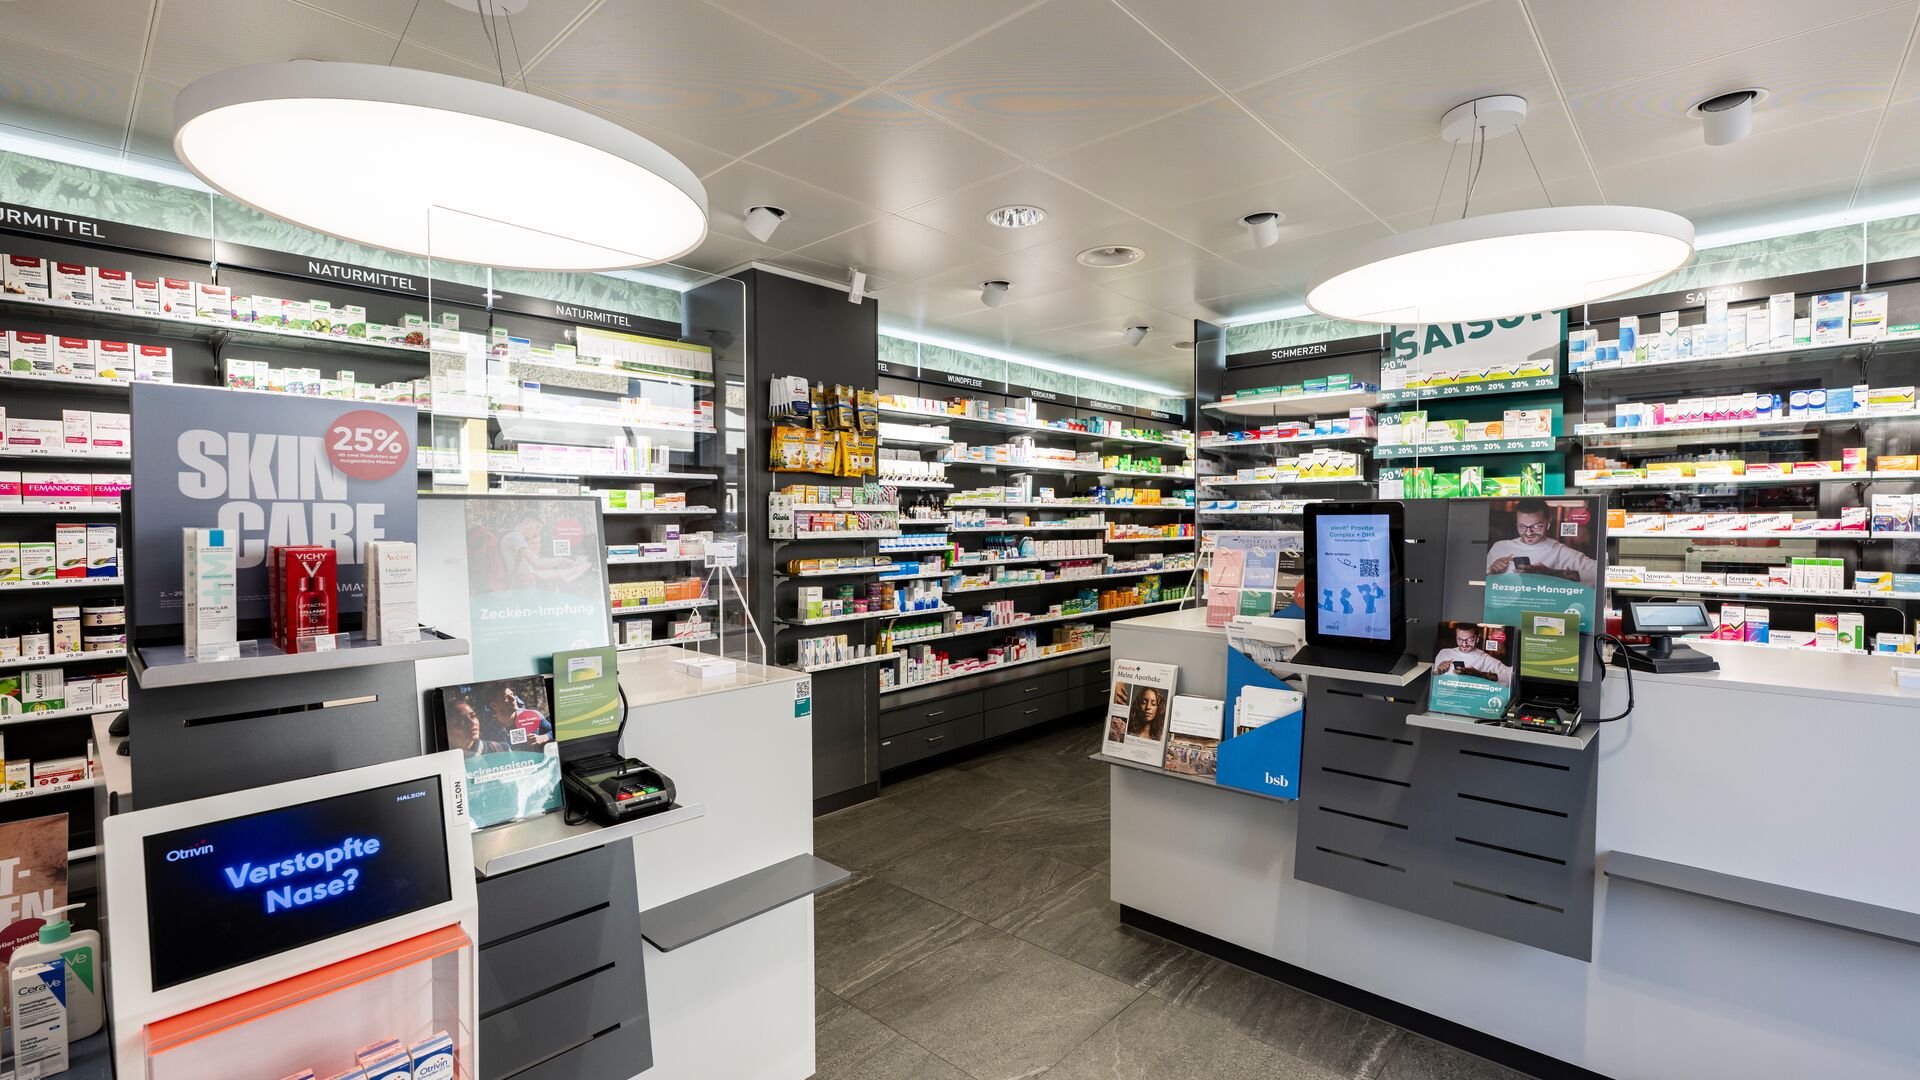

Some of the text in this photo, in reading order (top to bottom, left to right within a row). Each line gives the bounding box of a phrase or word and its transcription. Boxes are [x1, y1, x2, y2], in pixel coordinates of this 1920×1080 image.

[308, 260, 417, 292] NATURMITTEL
[556, 305, 632, 328] NATURMITTEL
[1272, 344, 1327, 360] SCHMERZEN
[947, 374, 982, 388] WUNDPFLEGE
[1535, 378, 1553, 386] 20%
[1030, 390, 1056, 400] VERDAUUNG
[333, 426, 402, 454] 25%
[177, 429, 348, 501] SKIN
[1762, 515, 1779, 524] angin
[218, 502, 386, 569] CARE
[1492, 583, 1584, 596] Rezepte-Manager
[480, 604, 594, 620] Zecken-Impfung
[1134, 673, 1161, 683] Apotheke
[466, 758, 534, 779] eckensaison
[1265, 772, 1288, 787] bsb
[166, 838, 214, 862] Otrivin
[224, 836, 380, 889] Verstopfte
[266, 868, 359, 914] Nase?
[16, 932, 38, 942] berat
[18, 979, 60, 996] CeraVe
[420, 1060, 448, 1075] Otrivin
